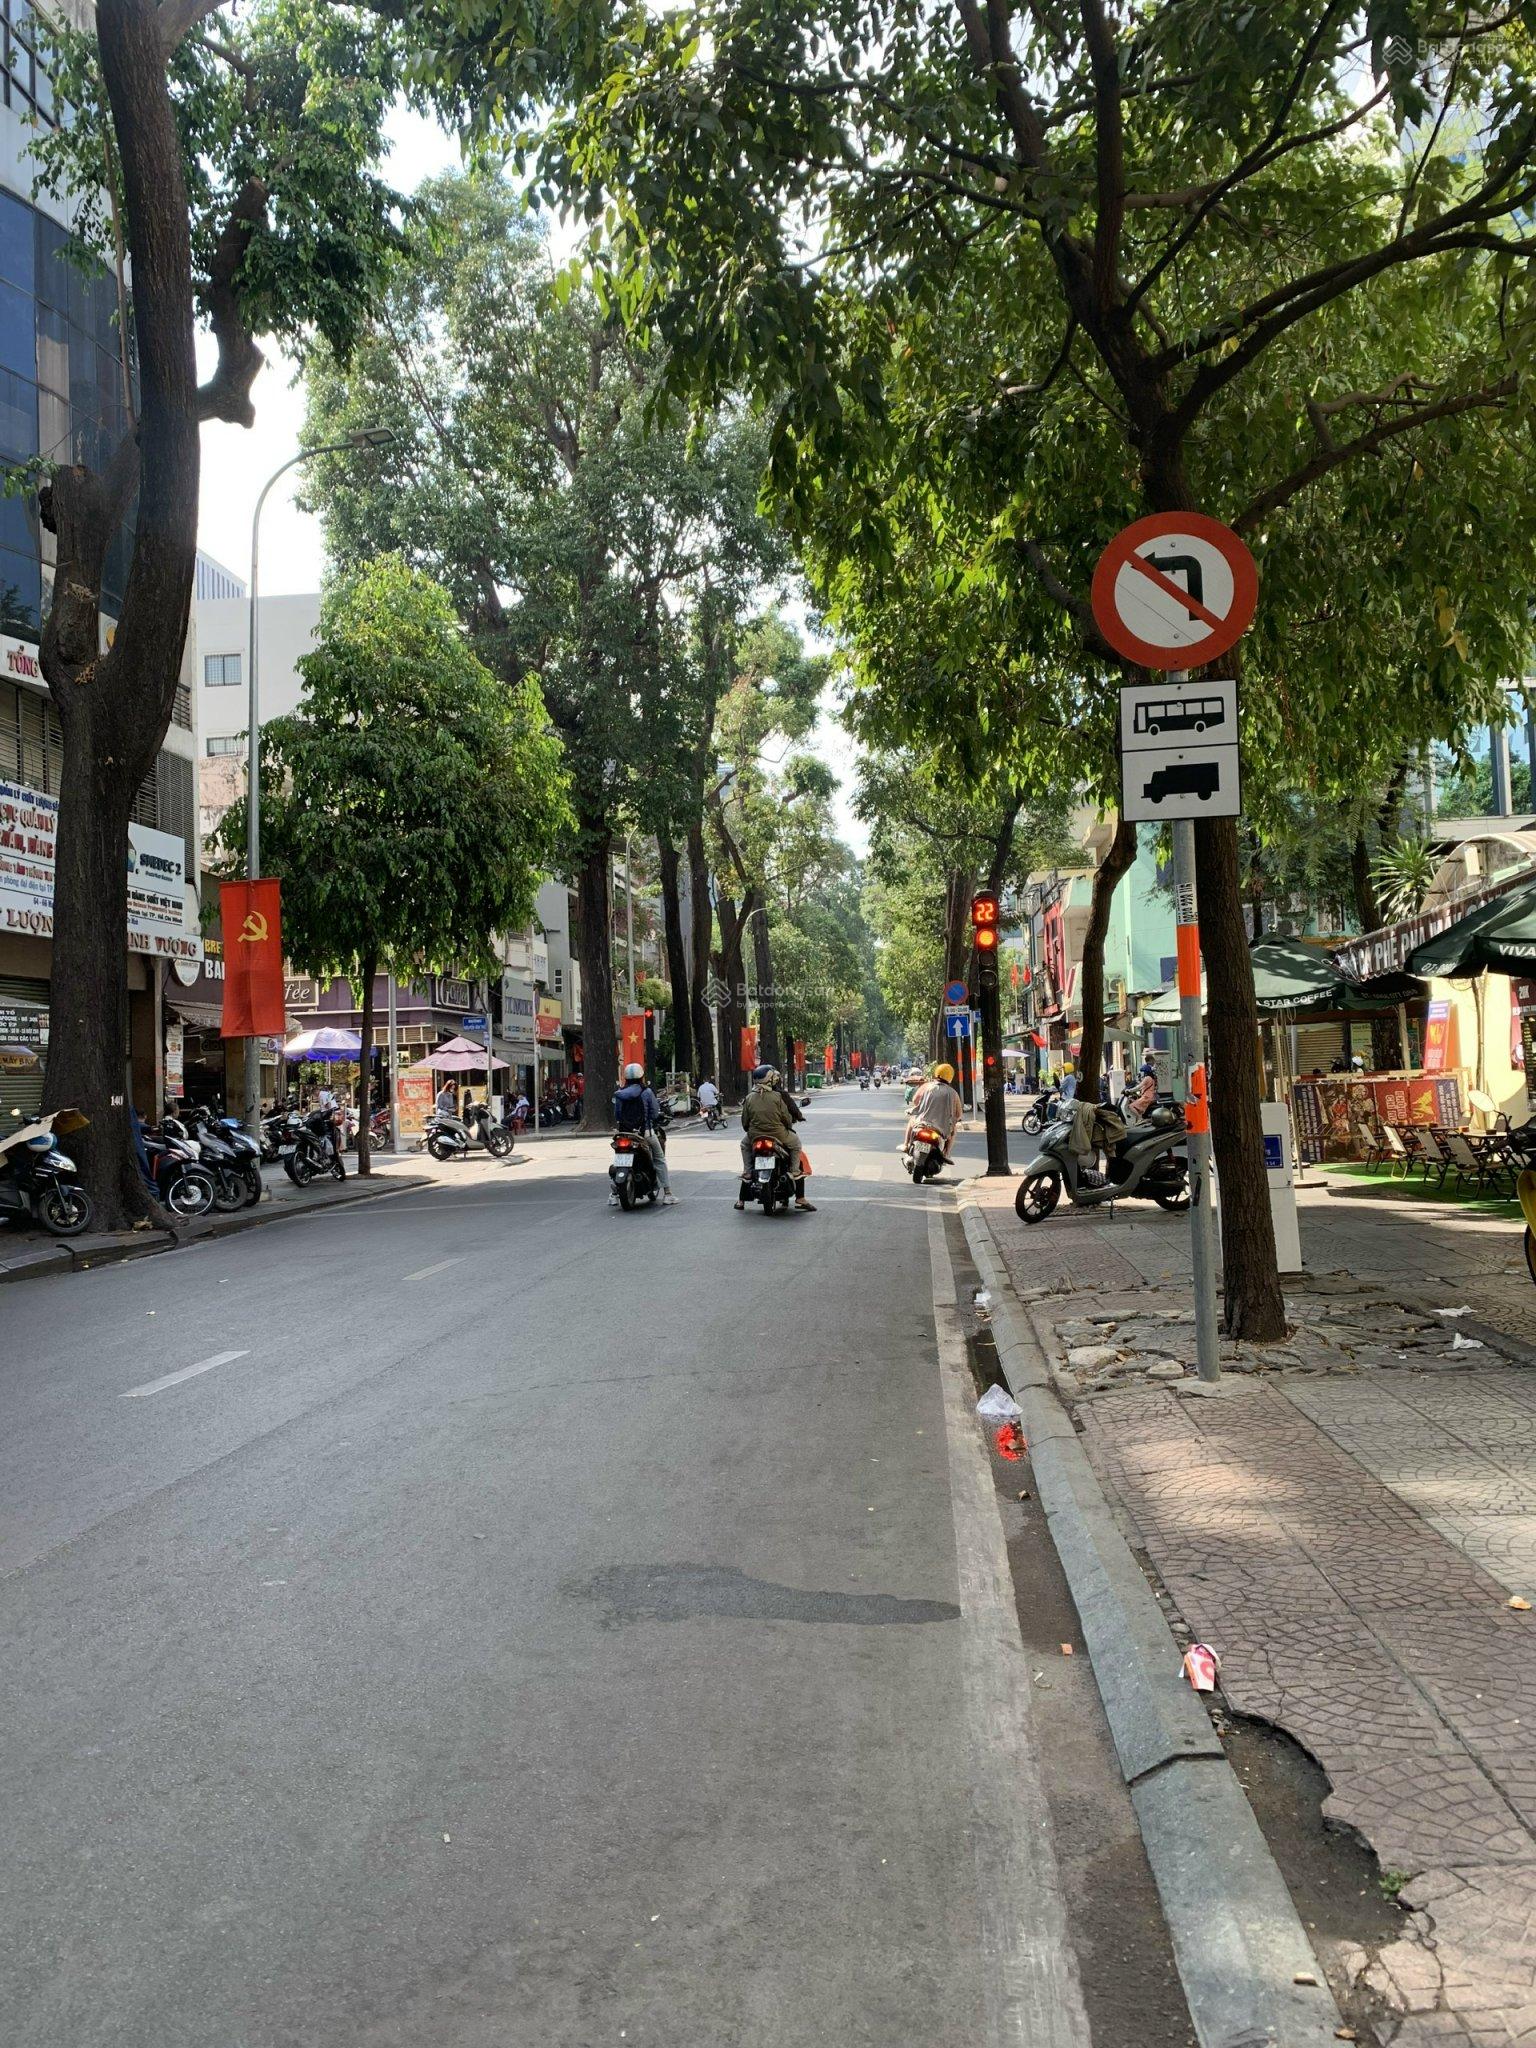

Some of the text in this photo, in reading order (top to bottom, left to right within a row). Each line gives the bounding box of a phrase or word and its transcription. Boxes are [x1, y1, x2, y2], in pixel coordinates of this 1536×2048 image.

[976, 903, 994, 921] 22
[1374, 930, 1399, 971] PHÊ
[1499, 944, 1536, 957] VIVA
[1263, 989, 1333, 1007] STAR COFFEE
